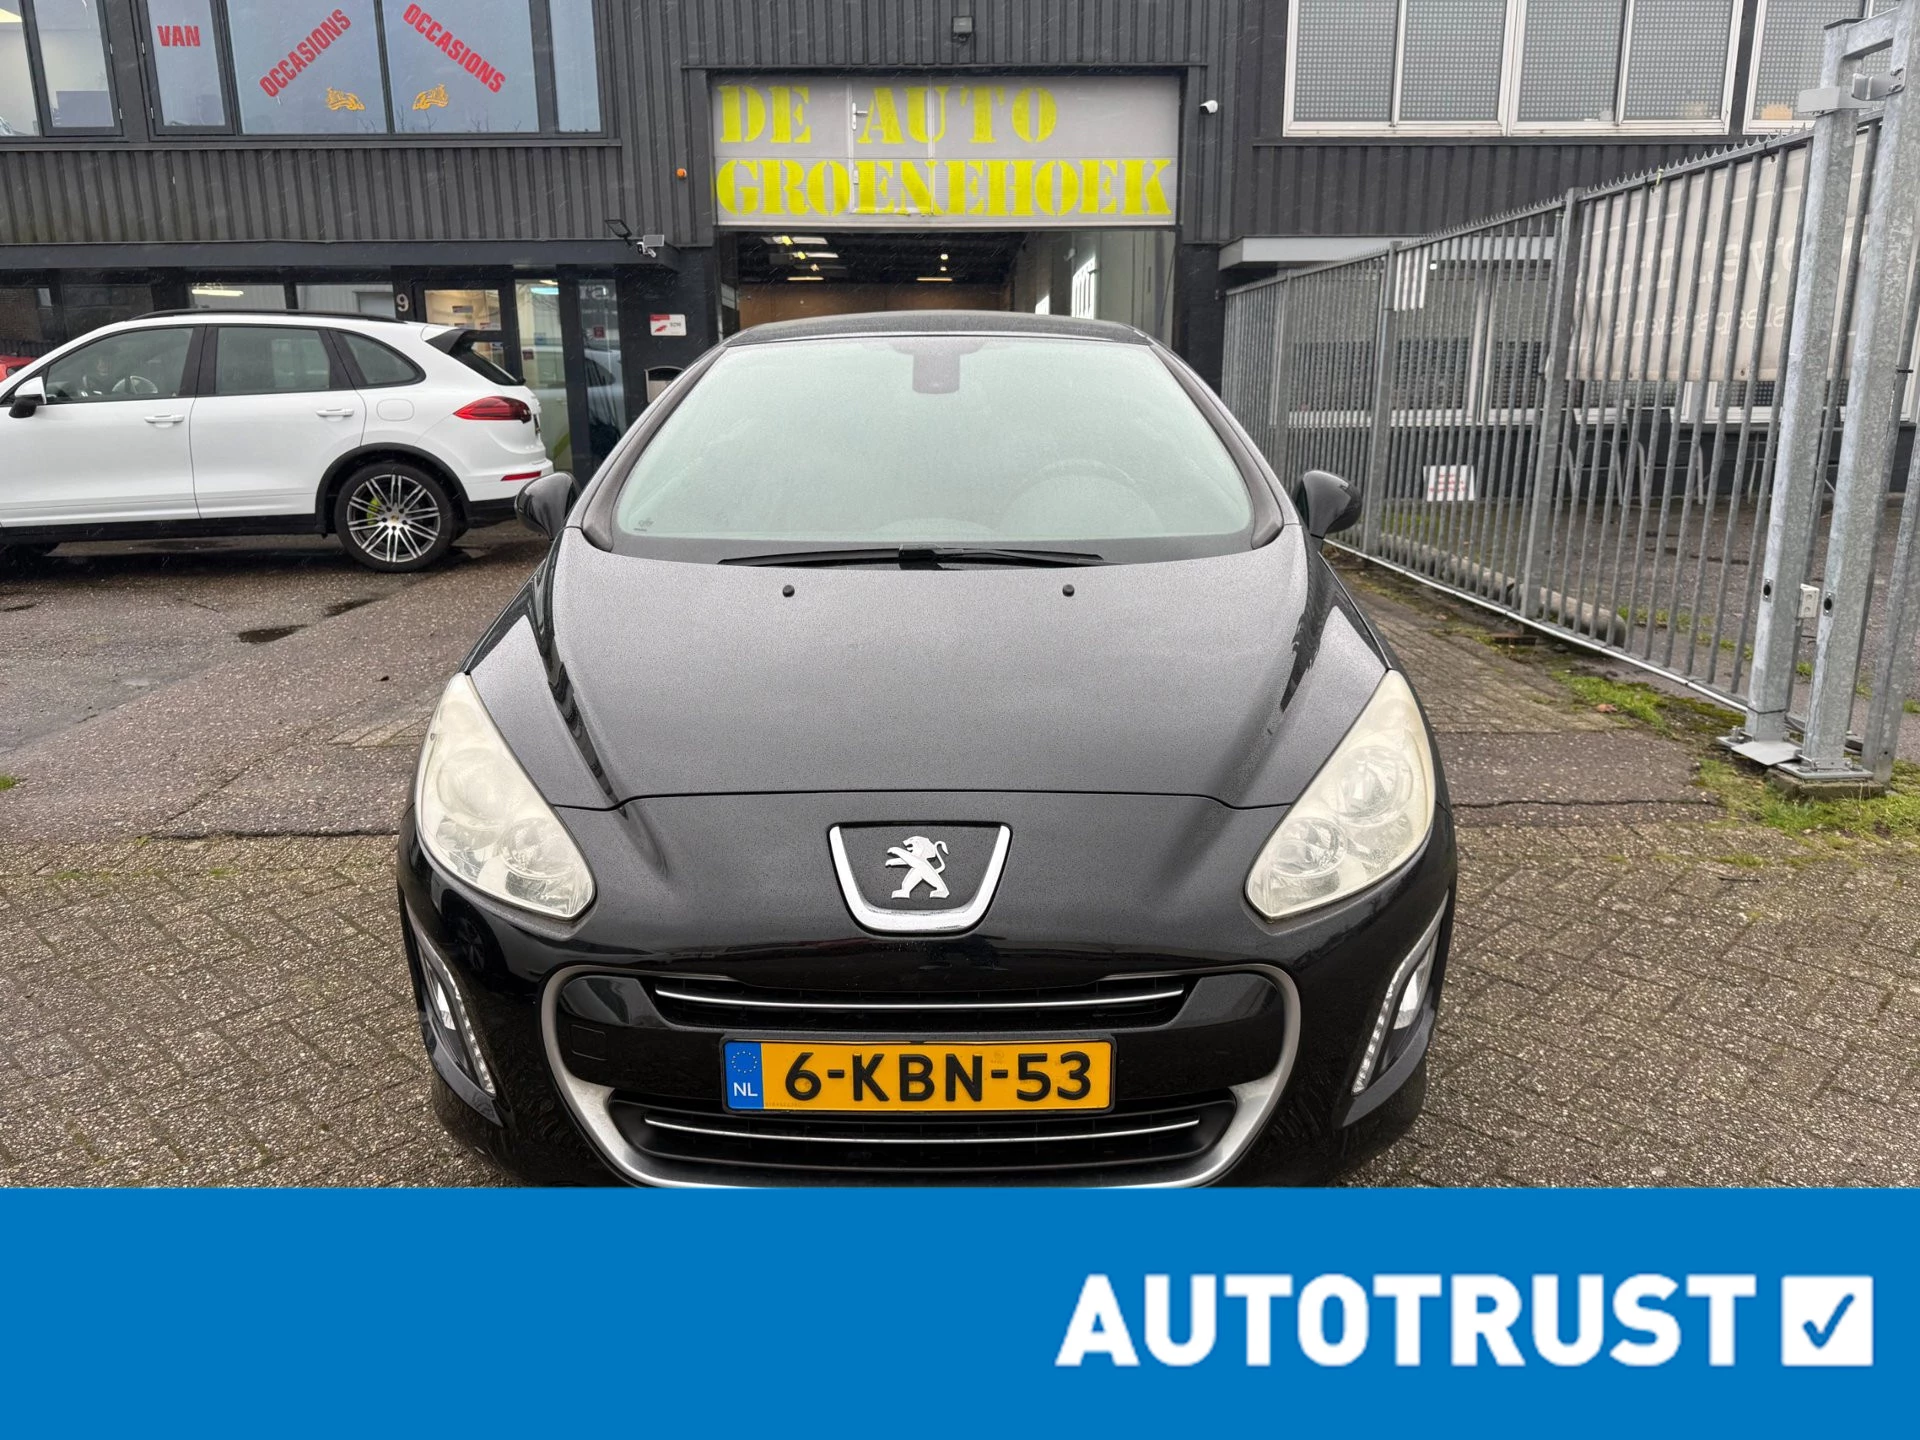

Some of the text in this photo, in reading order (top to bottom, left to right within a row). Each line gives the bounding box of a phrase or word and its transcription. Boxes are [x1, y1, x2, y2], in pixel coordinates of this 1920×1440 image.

[156, 24, 201, 47] VAN
[258, 8, 352, 98] OCCASIONS
[403, 2, 506, 93] OCCASIONS
[716, 84, 1059, 144] DE AUTO
[715, 158, 1172, 217] GROENEHOEK
[395, 293, 409, 312] 9
[733, 1082, 758, 1098] NL
[784, 1051, 1092, 1102] 6-KBN-53
